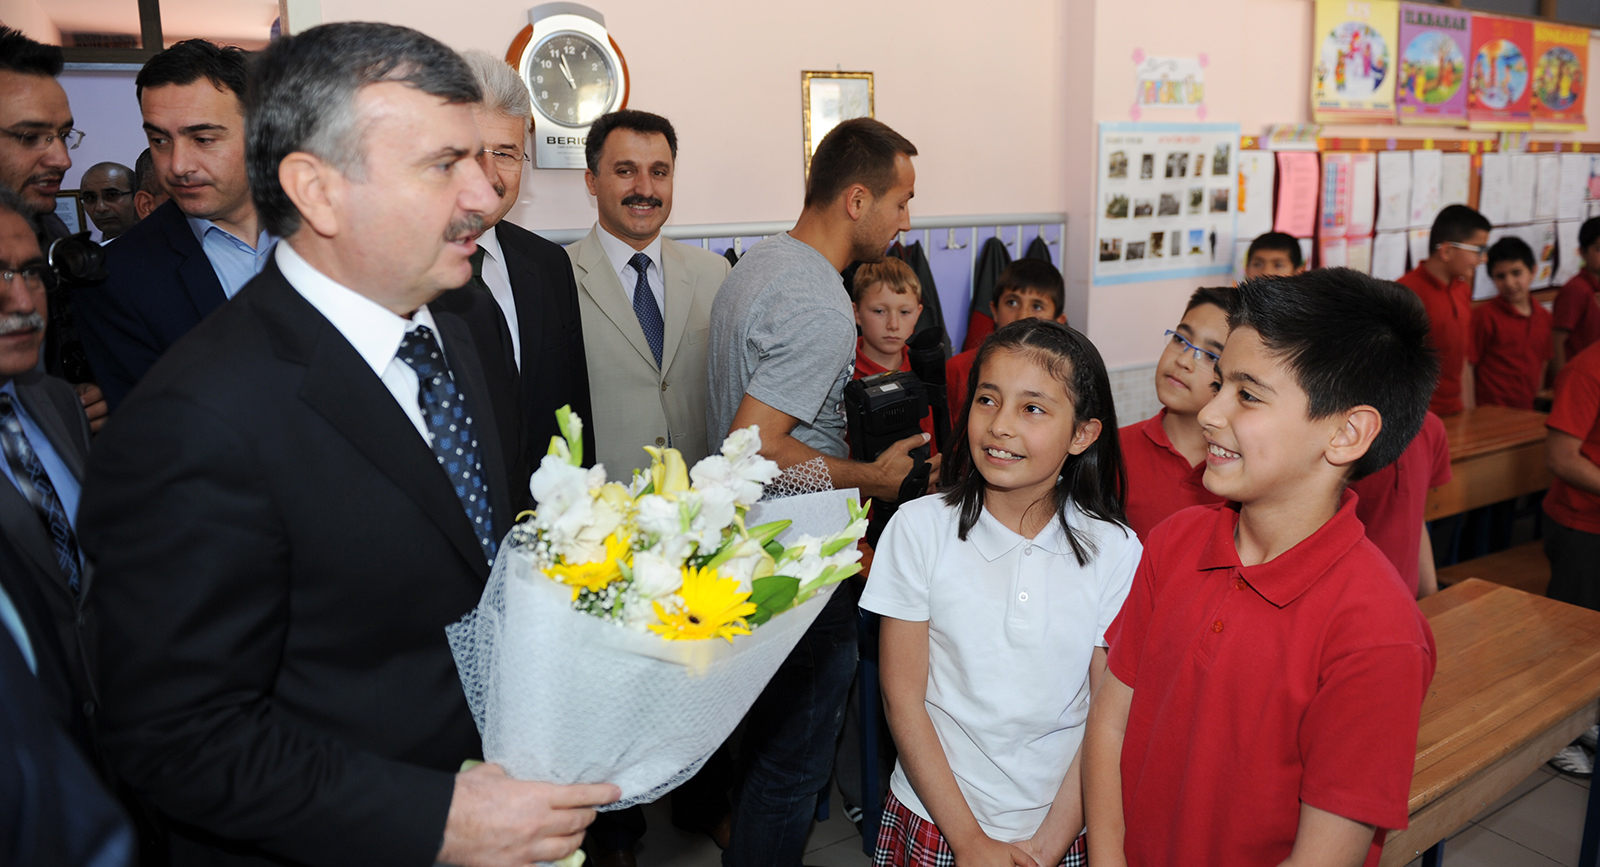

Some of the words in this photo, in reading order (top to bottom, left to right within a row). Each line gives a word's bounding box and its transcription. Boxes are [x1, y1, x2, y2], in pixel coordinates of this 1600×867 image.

[550, 49, 560, 58] 11
[563, 45, 576, 55] 12
[581, 51, 587, 60] 1
[540, 60, 552, 69] 10
[591, 62, 598, 71] 2
[536, 75, 544, 84] 9
[541, 90, 549, 100] 8
[552, 102, 560, 111] 7
[567, 107, 574, 116] 6
